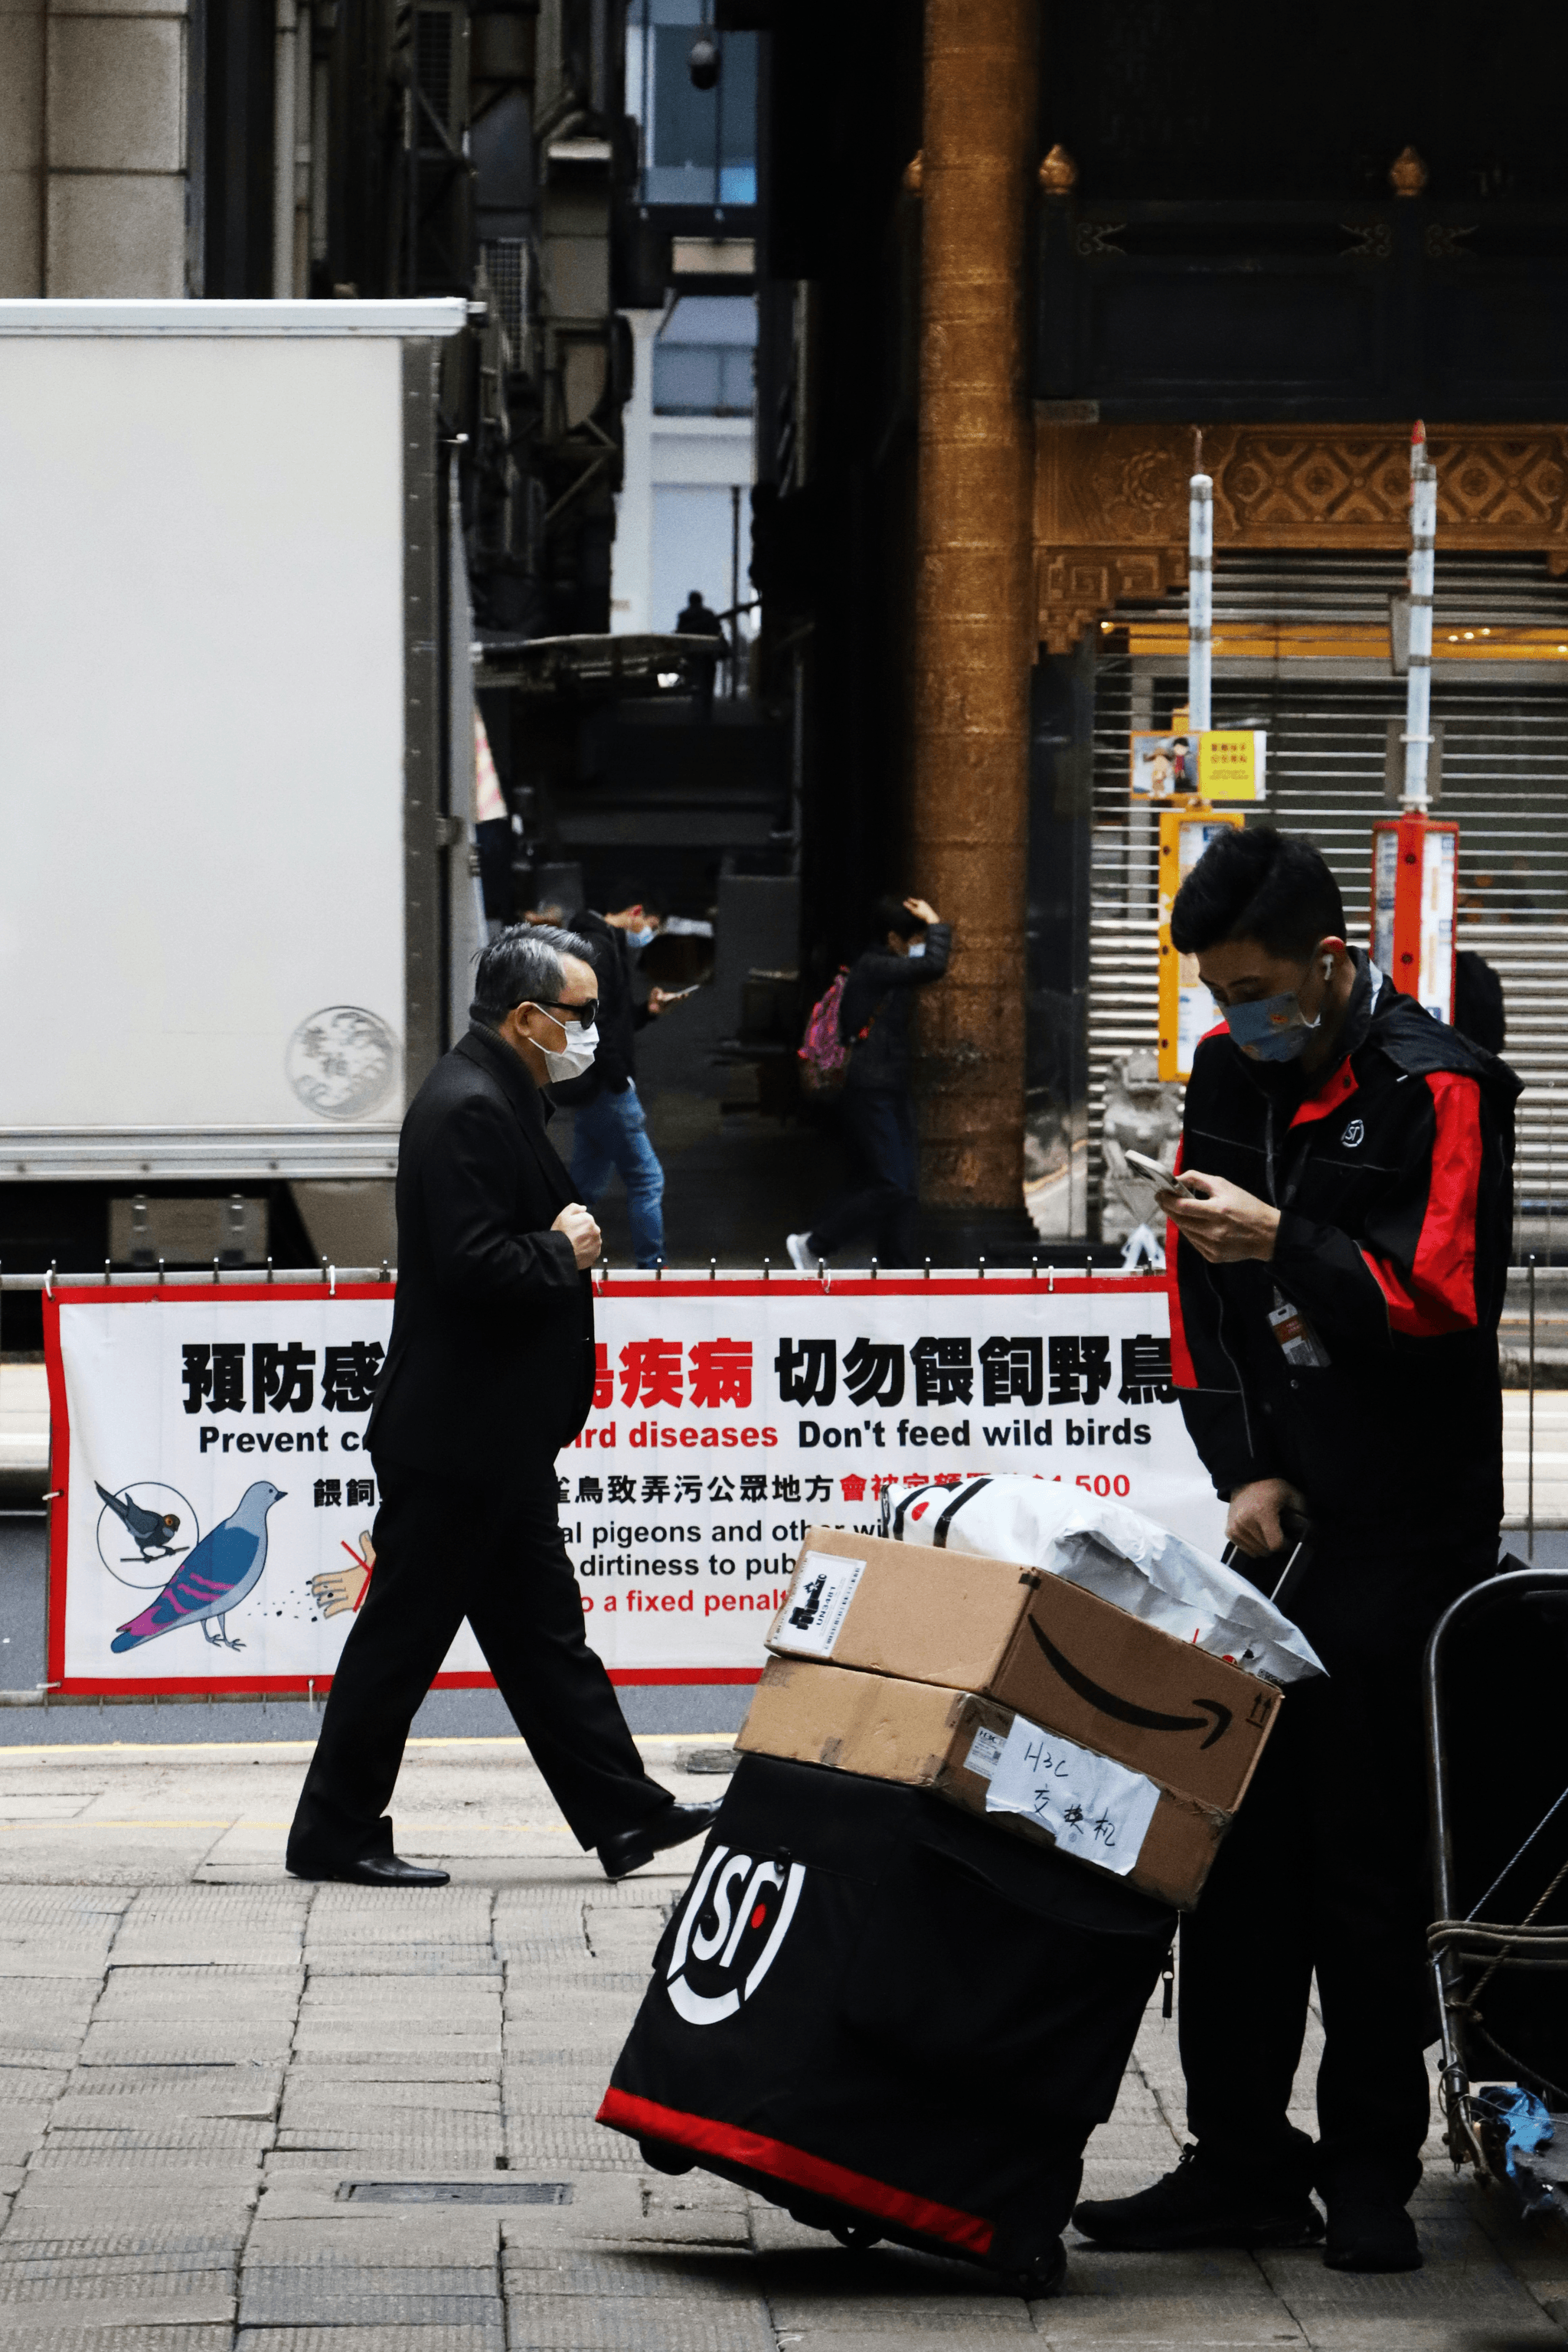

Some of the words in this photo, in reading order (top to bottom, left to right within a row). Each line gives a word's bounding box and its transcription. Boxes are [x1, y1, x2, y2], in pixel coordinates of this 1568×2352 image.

[181, 1341, 385, 1414] 預防感
[592, 1337, 753, 1409] 疾病
[774, 1334, 1180, 1407] 切勿餵飼野鳥
[199, 1425, 328, 1453] Prevent
[561, 1421, 616, 1449] ird
[629, 1420, 778, 1449] diseases
[799, 1420, 885, 1449] Don't
[897, 1419, 971, 1447] feed
[982, 1419, 1053, 1447] wild
[1067, 1418, 1152, 1446] birds
[312, 1478, 382, 1508] 餵飼
[593, 1520, 701, 1549] pigeons
[711, 1520, 763, 1543] and
[853, 1518, 882, 1538] wi
[580, 1553, 699, 1577] dirtiness
[709, 1553, 736, 1575] to
[746, 1552, 796, 1580] pub
[603, 1595, 617, 1613] a
[626, 1589, 694, 1612] fixed
[815, 1586, 836, 1626] UN3481
